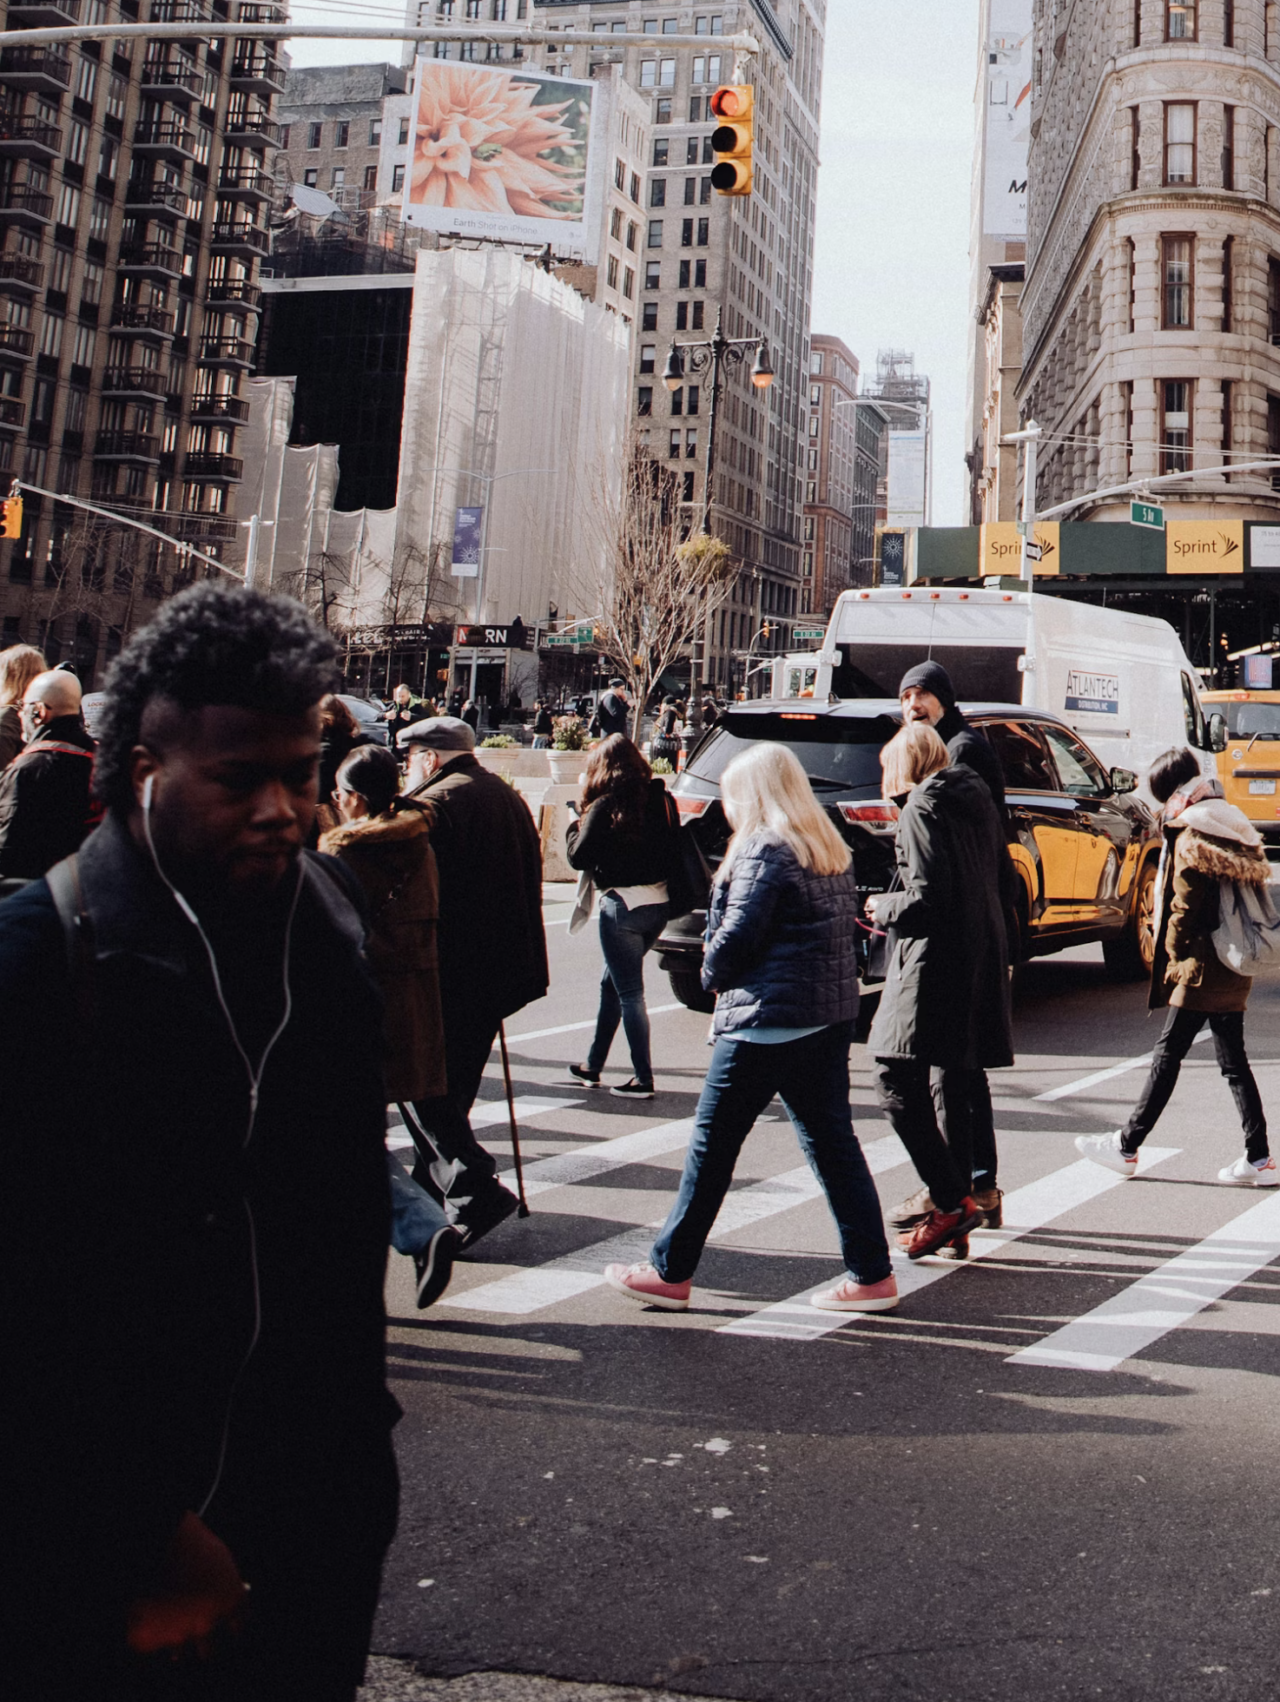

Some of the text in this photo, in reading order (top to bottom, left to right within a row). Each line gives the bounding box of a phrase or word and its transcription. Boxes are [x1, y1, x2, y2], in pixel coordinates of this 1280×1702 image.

[453, 218, 476, 228] Earth
[477, 221, 497, 231] Shot
[510, 224, 538, 235] iPhone
[1142, 507, 1155, 522] 5 Av
[991, 541, 1022, 558] Spri
[1173, 539, 1217, 557] Sprint
[1066, 669, 1119, 699] ATLANTECH
